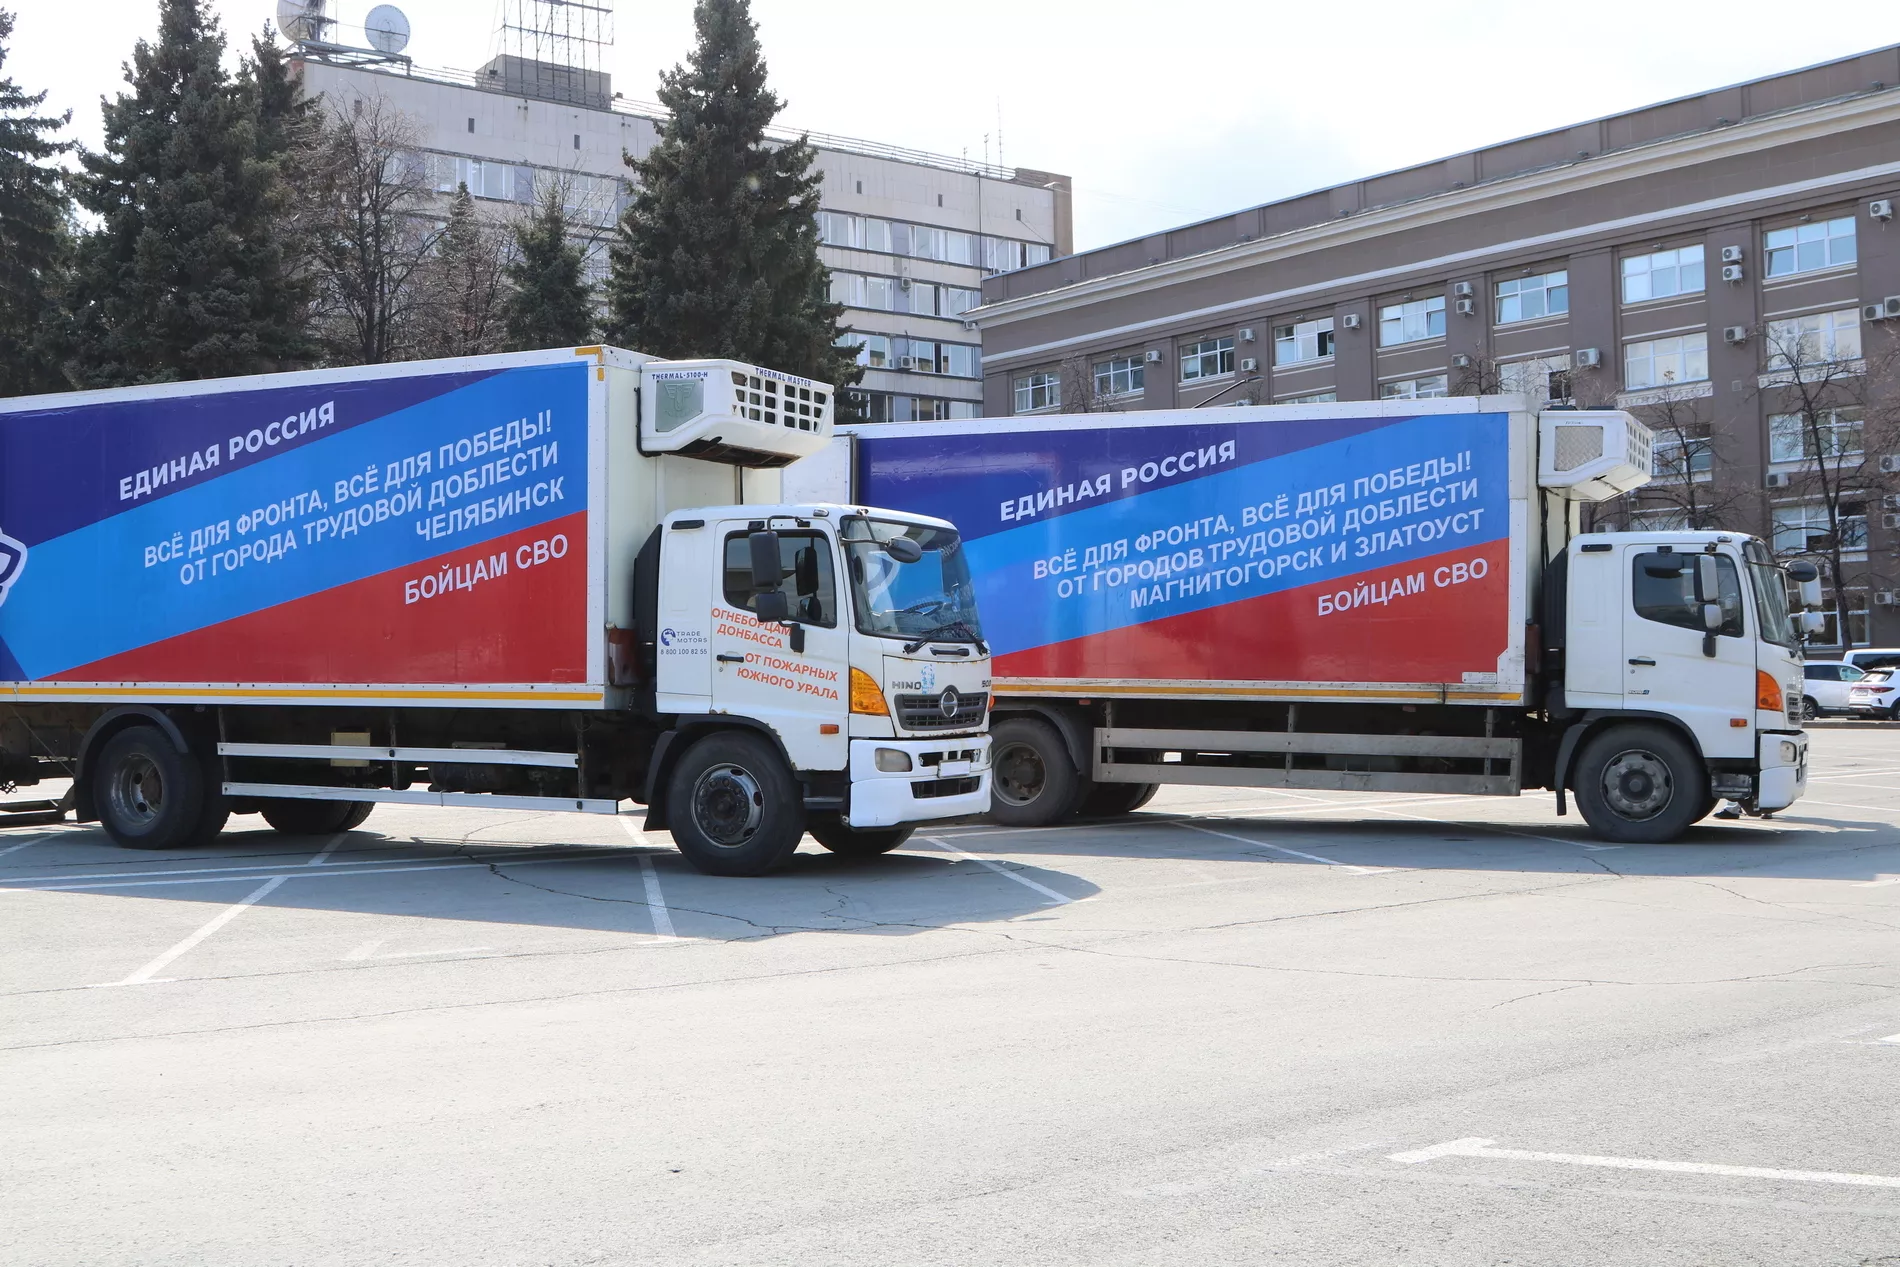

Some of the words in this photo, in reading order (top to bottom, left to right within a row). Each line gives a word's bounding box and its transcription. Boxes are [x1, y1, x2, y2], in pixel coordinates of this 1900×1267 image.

[755, 368, 786, 381] THERMAL
[787, 376, 812, 387] MASTER
[119, 443, 220, 501] ЕДИНАЯ
[229, 401, 335, 461] РОССИЯ
[1001, 473, 1110, 521] ЕДИНАЯ
[1122, 440, 1235, 488] РОССИЯ
[145, 532, 183, 568] ВСЁ
[188, 520, 230, 558] ДЛЯ
[236, 490, 328, 535] ФРОНТА,
[335, 465, 379, 504] ВСЁ
[384, 451, 431, 494] ДЛЯ
[439, 409, 552, 469] ПОБЕДЫ!
[181, 558, 208, 586] ОТ
[212, 531, 297, 576] ГОРОДА
[304, 483, 422, 546] ТРУДОВОЙ
[428, 442, 558, 512] ДОБЛЕСТИ
[415, 477, 564, 541] ЧЕЛЯБИНСК
[1034, 548, 1077, 579] ВСЁ
[1083, 538, 1128, 572] ДЛЯ
[1135, 514, 1235, 553] ФРОНТА,
[1243, 494, 1289, 527] ВСЁ
[1295, 483, 1345, 519] ДЛЯ
[1354, 450, 1471, 499] ПОБЕДЫ!
[404, 552, 507, 605] БОЙЦАМ
[515, 534, 568, 570] СВО
[1057, 575, 1087, 598] ОТ
[1094, 549, 1204, 591] ГОРОДОВ
[1208, 509, 1336, 564] ТРУДОВОЙ
[1343, 478, 1477, 536] ДОБЛЕСТИ
[1130, 547, 1324, 609] МАГНИТОГОРСК
[1332, 541, 1347, 564] И
[1355, 508, 1484, 557] ЗЛАТОУСТ
[1318, 571, 1425, 616] БОЙЦАМ
[1433, 558, 1488, 588] СВО
[717, 624, 782, 648] ДОНБАССА
[745, 653, 761, 664] ОТ
[763, 656, 838, 682] ПОЖАРНЫХ
[737, 667, 794, 689] ЮЖНОГО
[797, 682, 838, 700] УРАЛА
[892, 681, 921, 690] HINO
